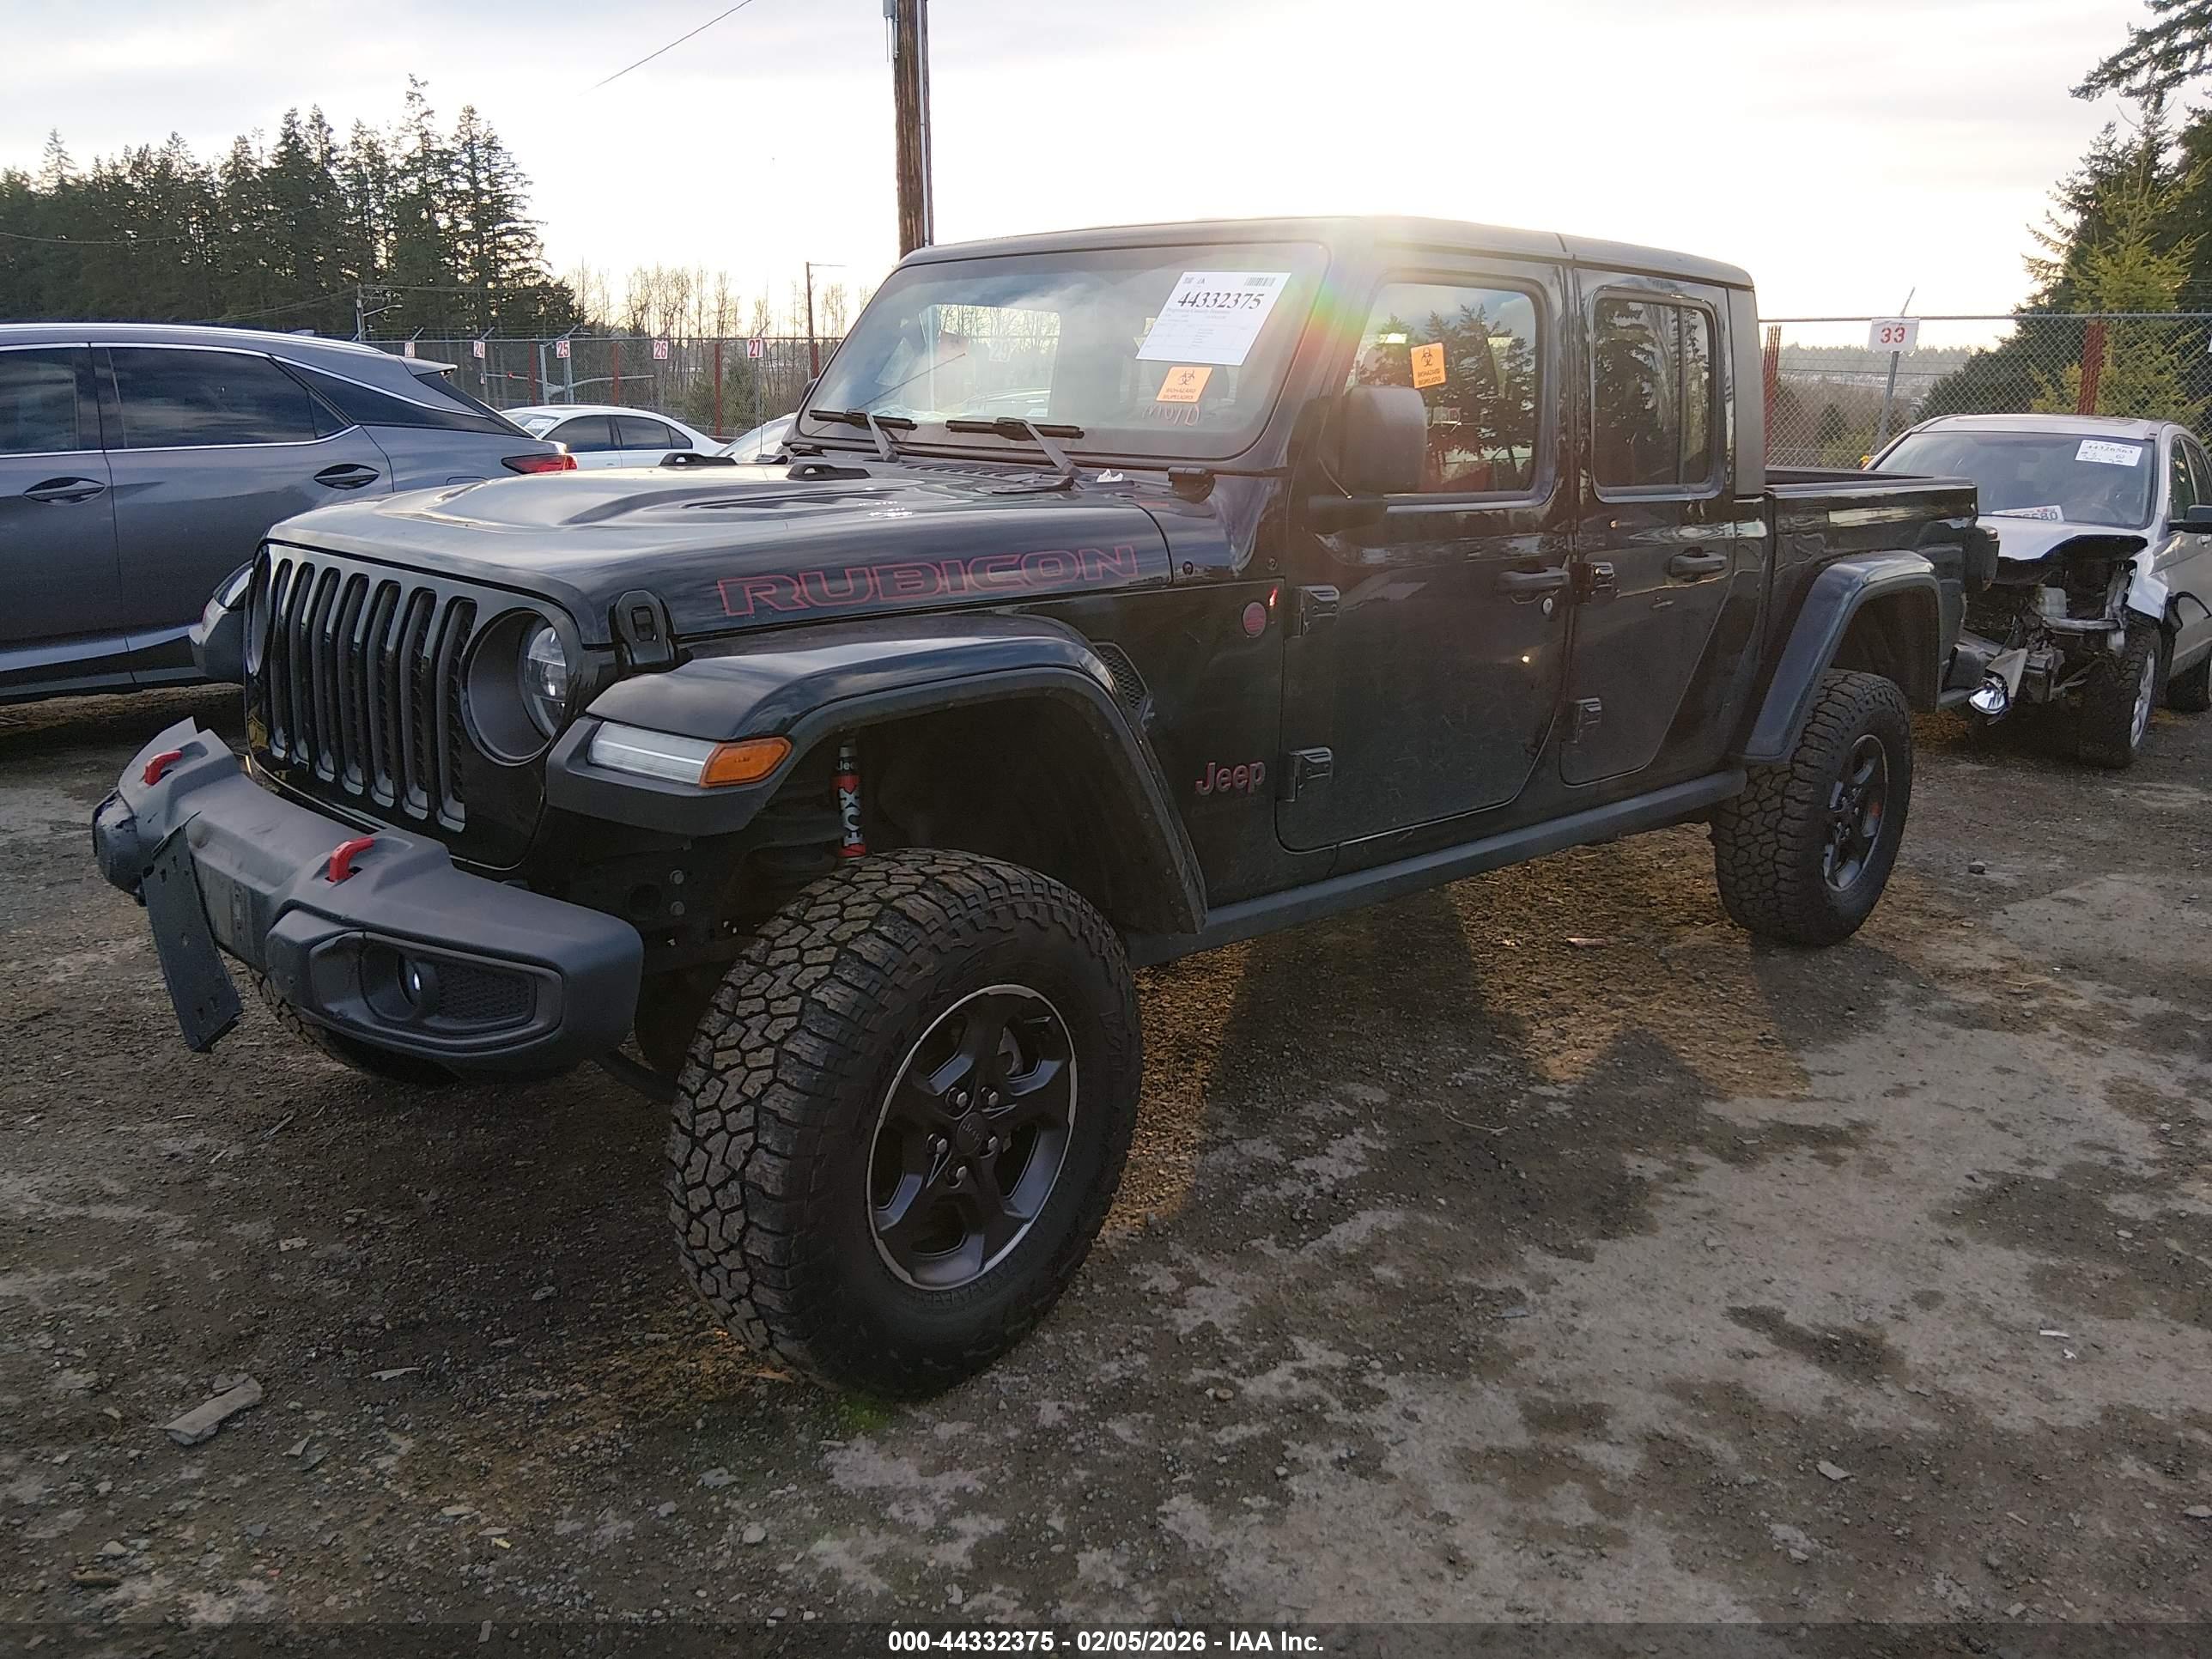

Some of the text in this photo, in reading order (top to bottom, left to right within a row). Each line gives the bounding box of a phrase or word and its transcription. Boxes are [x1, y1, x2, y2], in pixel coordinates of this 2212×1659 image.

[1177, 291, 1265, 310] 44332375
[1880, 326, 1905, 343] 33
[474, 342, 484, 357] 24
[557, 342, 569, 357] 25
[654, 343, 667, 358] 26
[749, 339, 761, 357] 27
[715, 544, 1139, 617] RUBICON
[1194, 761, 1267, 796] Jeep
